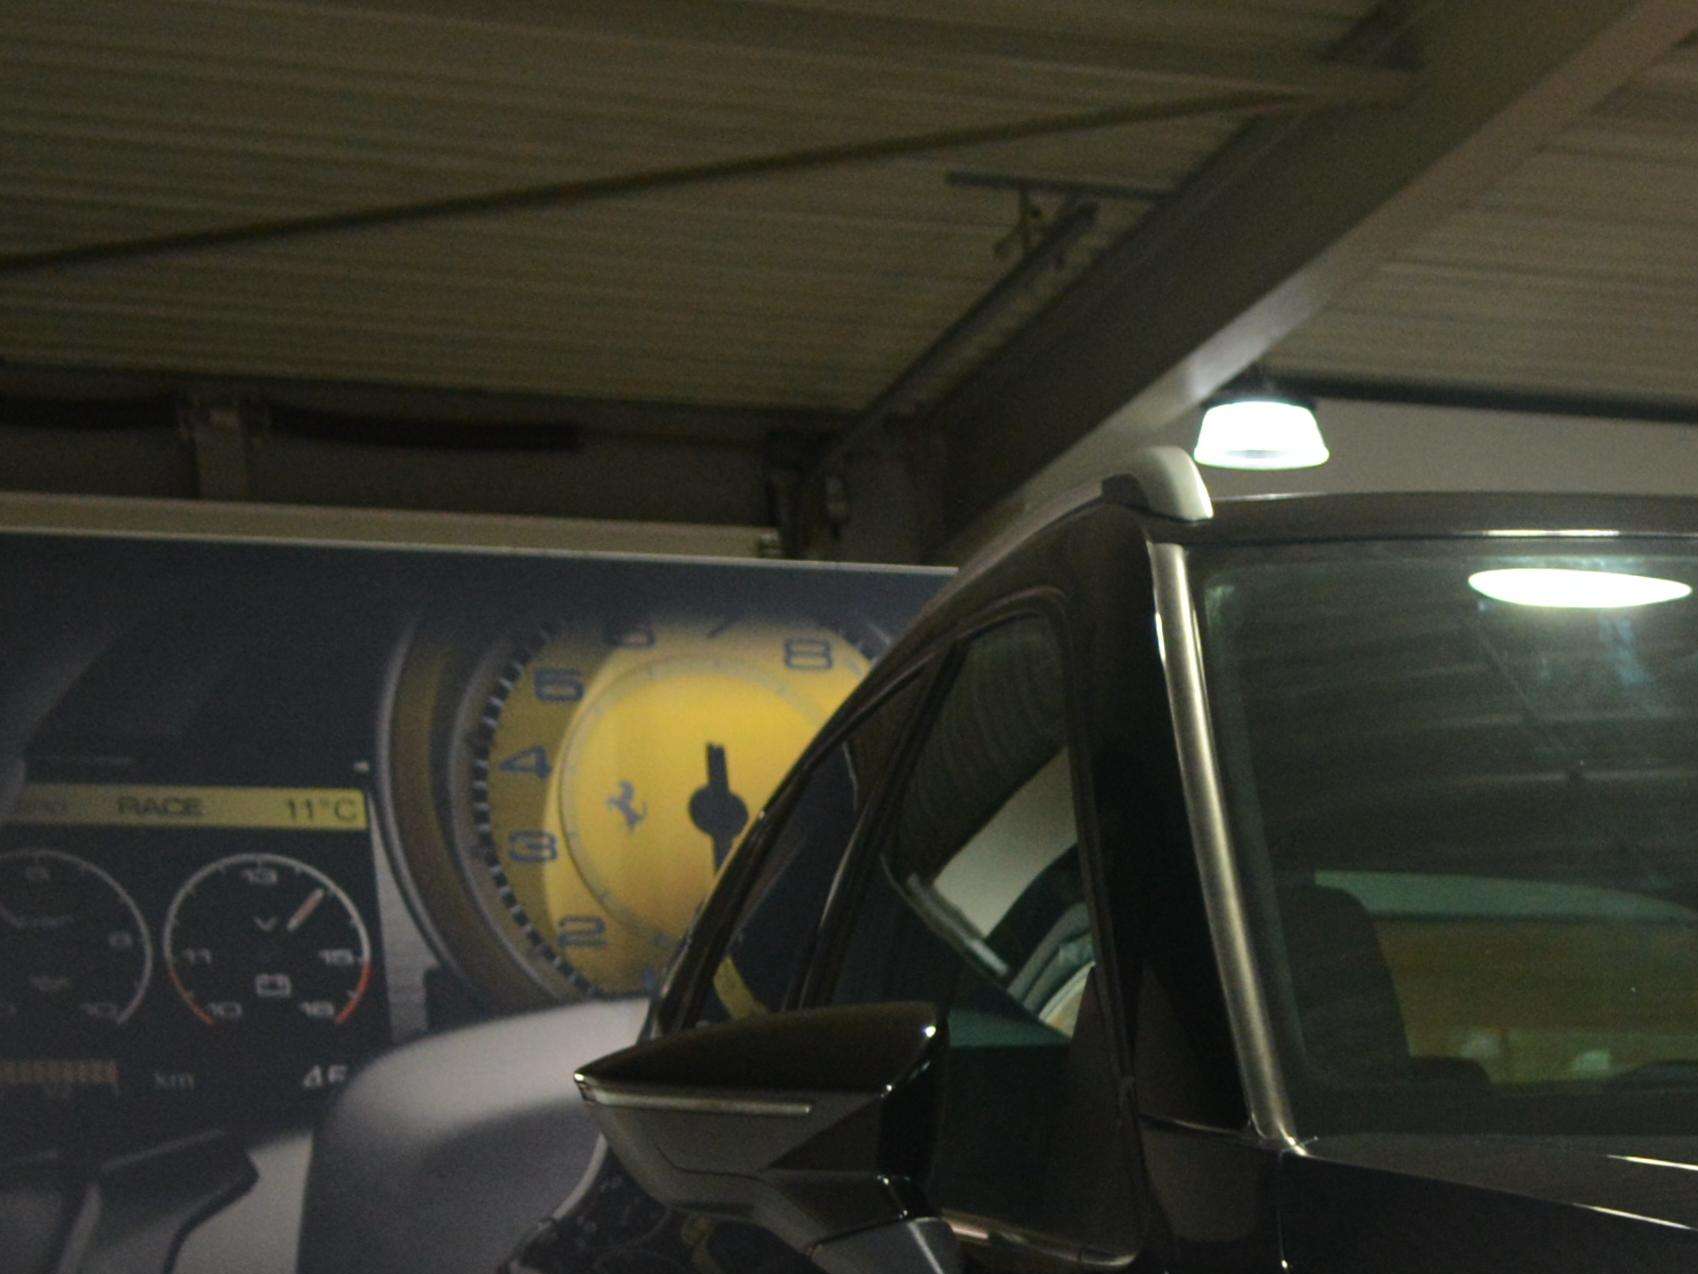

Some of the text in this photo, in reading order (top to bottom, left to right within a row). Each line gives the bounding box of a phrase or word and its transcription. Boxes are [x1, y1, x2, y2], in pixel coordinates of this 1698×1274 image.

[784, 638, 832, 671] 8
[499, 746, 553, 780] 4
[117, 796, 203, 818] RACE
[507, 830, 558, 864] 3
[556, 914, 607, 949] 2
